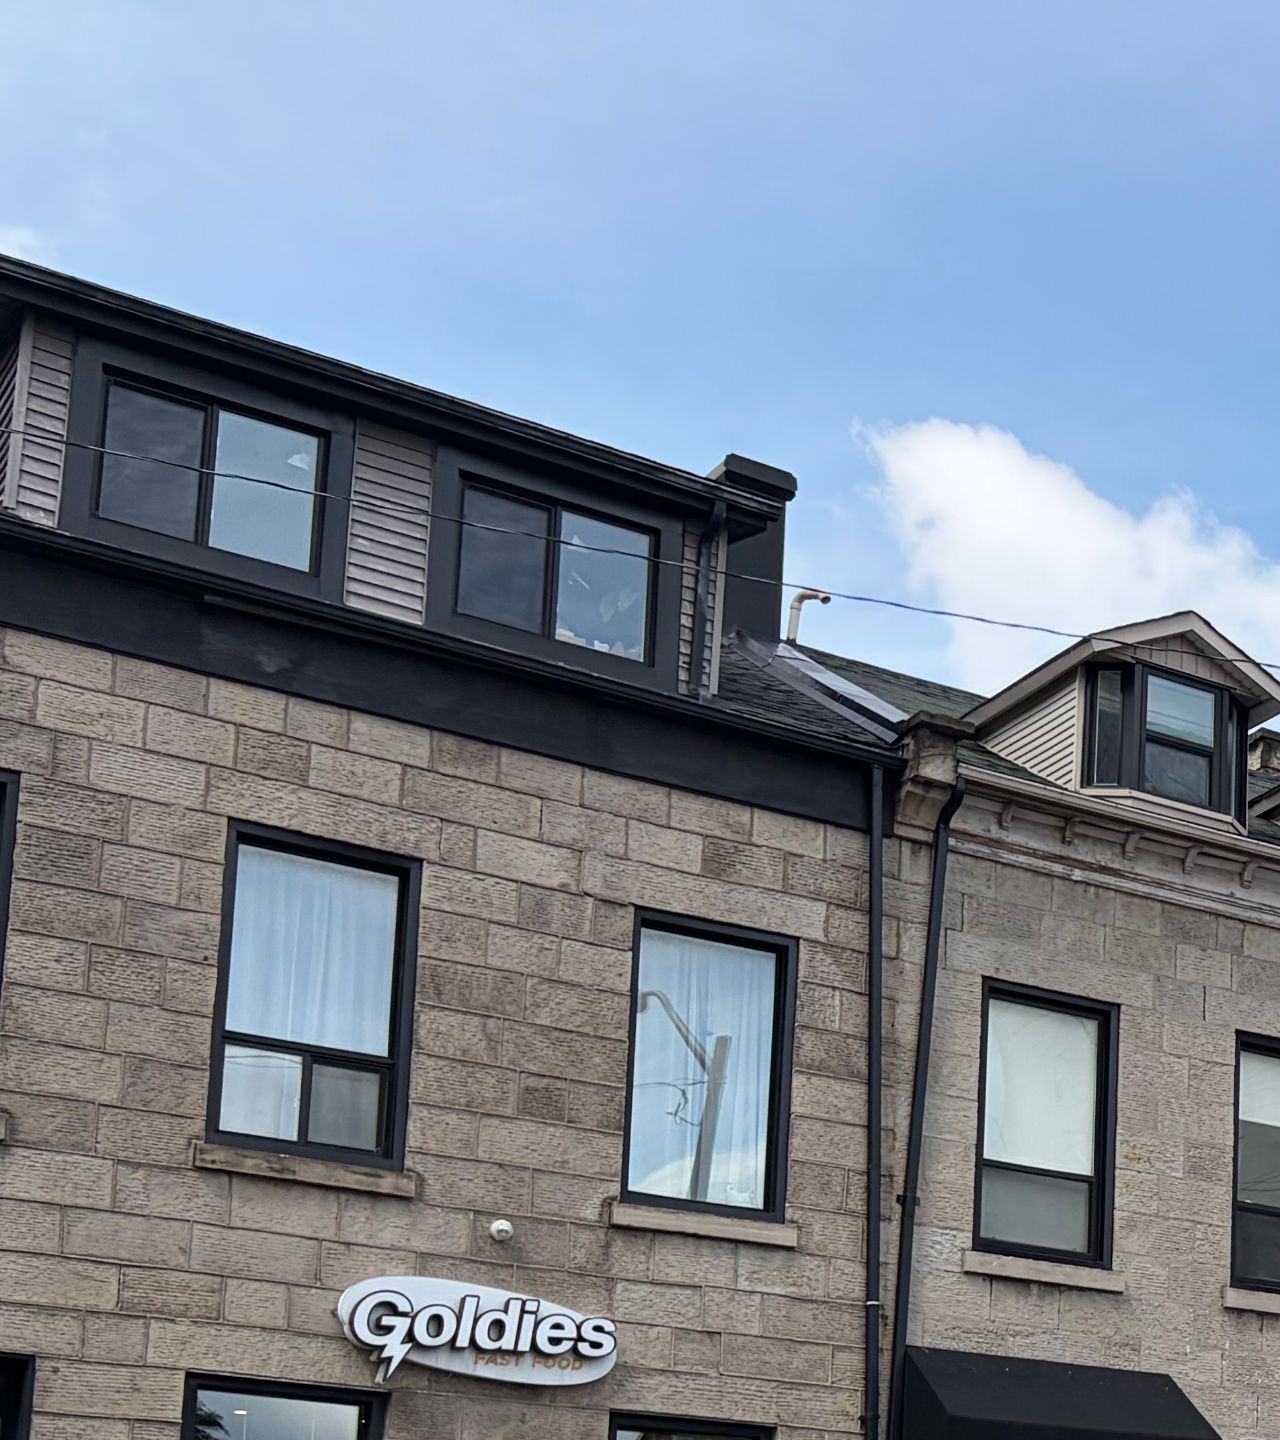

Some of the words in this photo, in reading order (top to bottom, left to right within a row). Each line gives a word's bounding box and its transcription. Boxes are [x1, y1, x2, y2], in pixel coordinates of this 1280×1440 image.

[352, 1290, 617, 1378] Goldies
[474, 1351, 523, 1367] FAST
[531, 1356, 585, 1371] FOOD
